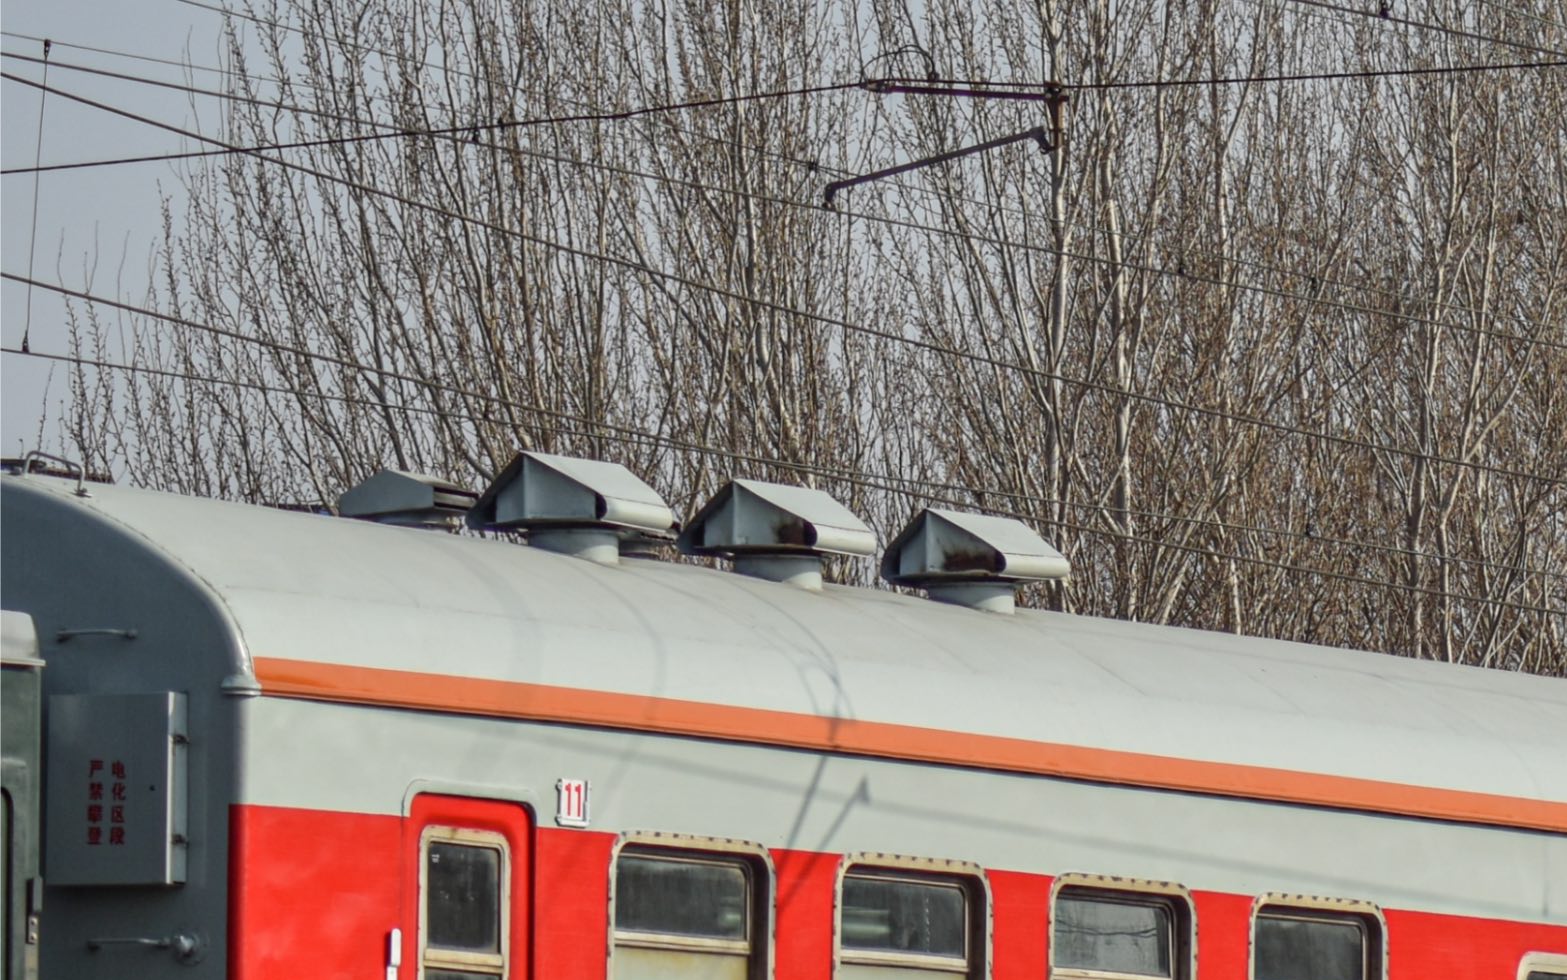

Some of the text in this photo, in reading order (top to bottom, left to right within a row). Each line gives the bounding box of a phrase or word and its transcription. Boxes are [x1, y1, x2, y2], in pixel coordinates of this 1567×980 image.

[111, 760, 126, 845] 电化区段
[564, 783, 582, 817] 11
